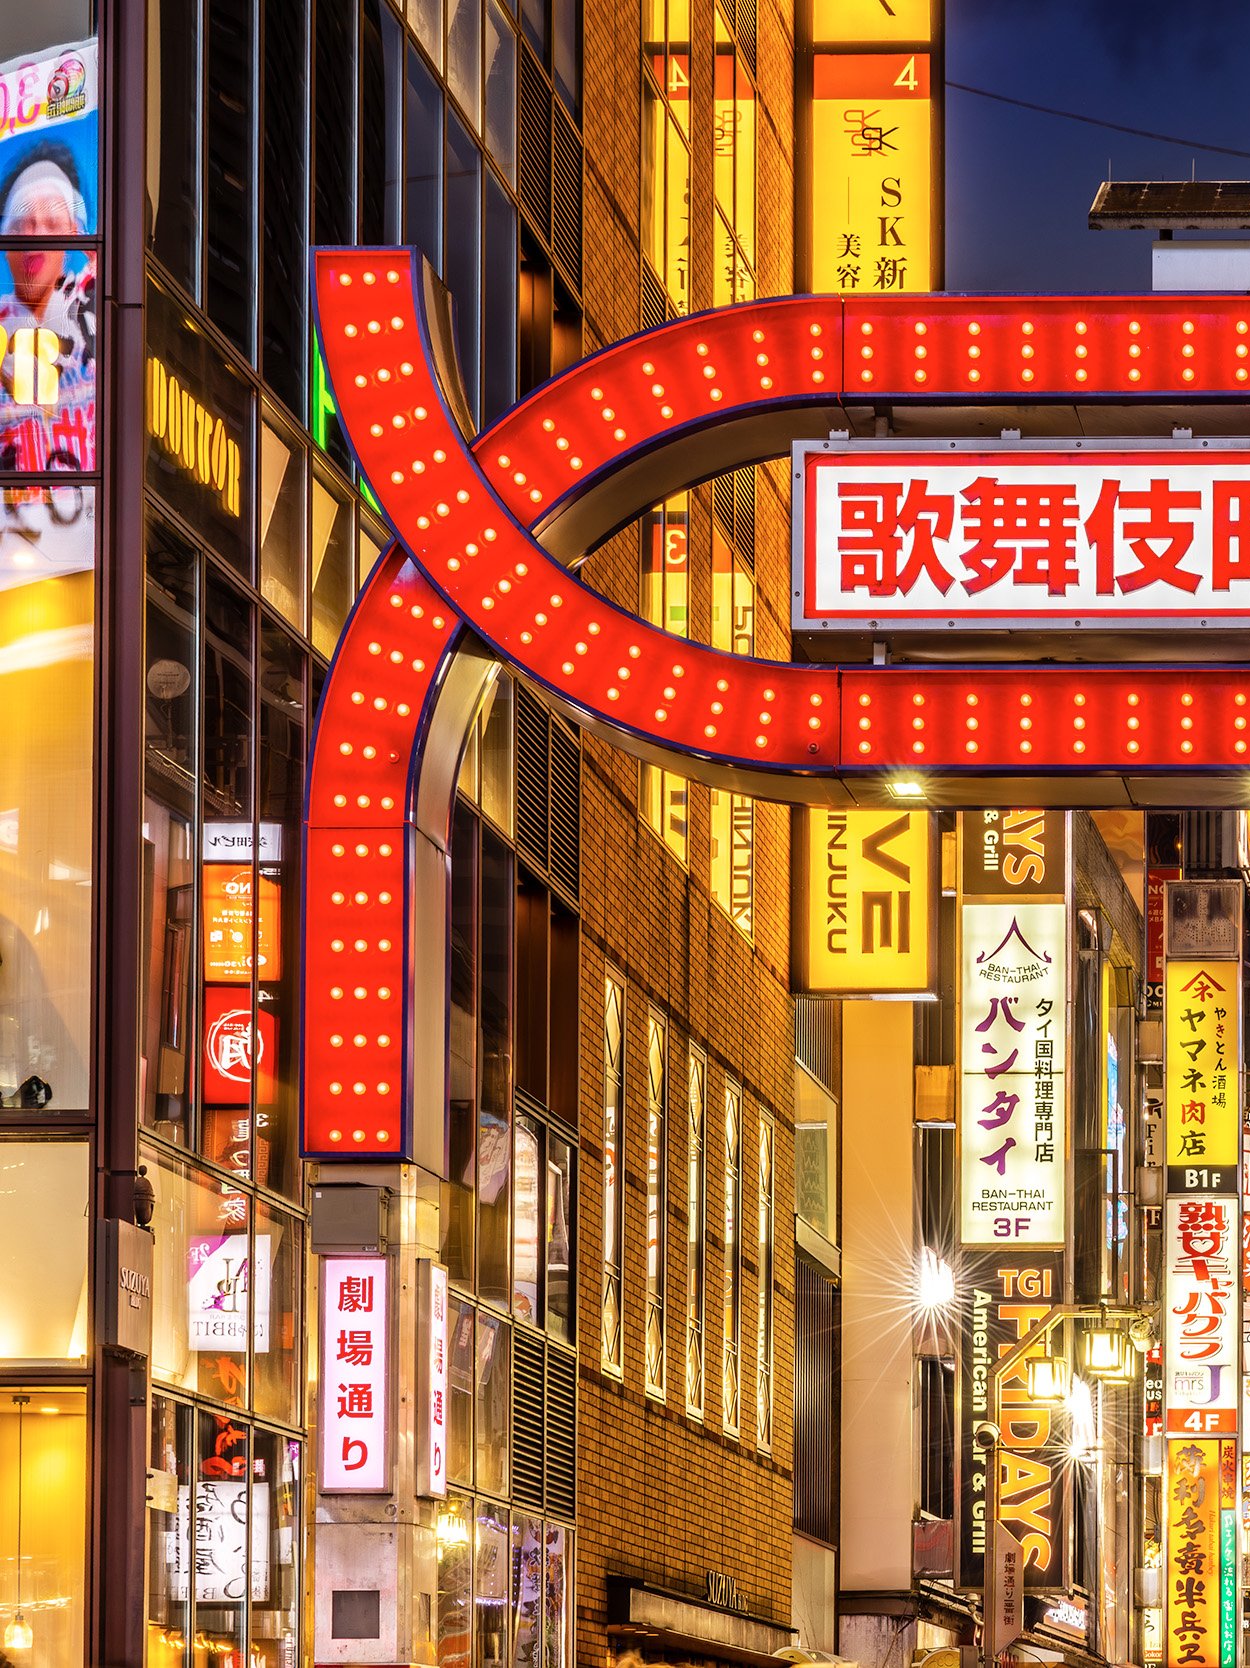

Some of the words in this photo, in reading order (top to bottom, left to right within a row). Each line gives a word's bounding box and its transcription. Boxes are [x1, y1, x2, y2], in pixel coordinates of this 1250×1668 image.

[893, 56, 918, 90] 4
[837, 233, 862, 289] 美容
[150, 357, 241, 518] DOUTOR
[984, 829, 999, 870] Grill
[979, 967, 1050, 984] RESTAURANT
[987, 962, 1041, 976] BAN-THAI
[1034, 998, 1055, 1164] タイ国料理専門店
[1211, 1007, 1228, 1109] やきとん酒場
[975, 997, 1026, 1176] バンタイ
[1177, 1008, 1207, 1158] ヤマネ肉店
[981, 1189, 1045, 1199] BAN-THAI
[1185, 1169, 1221, 1188] B1F
[972, 1201, 1054, 1211] RESTAURANT
[992, 1218, 1032, 1237] 3F
[120, 1266, 150, 1297] SUZUYA
[998, 1269, 1052, 1298] TGI
[1172, 1202, 1235, 1361] 熟女キャバクラ
[336, 1276, 374, 1472] 劇場通り
[972, 1288, 992, 1412] American
[432, 1286, 446, 1477] 劇場通り
[1174, 1379, 1204, 1391] mrs
[1183, 1410, 1221, 1432] 4F
[1221, 1445, 1235, 1500] 炭火串焼
[972, 1499, 987, 1554] Grill
[707, 1570, 737, 1610] SUZUYA
[1003, 1552, 1016, 1626] 劇場通り一番街
